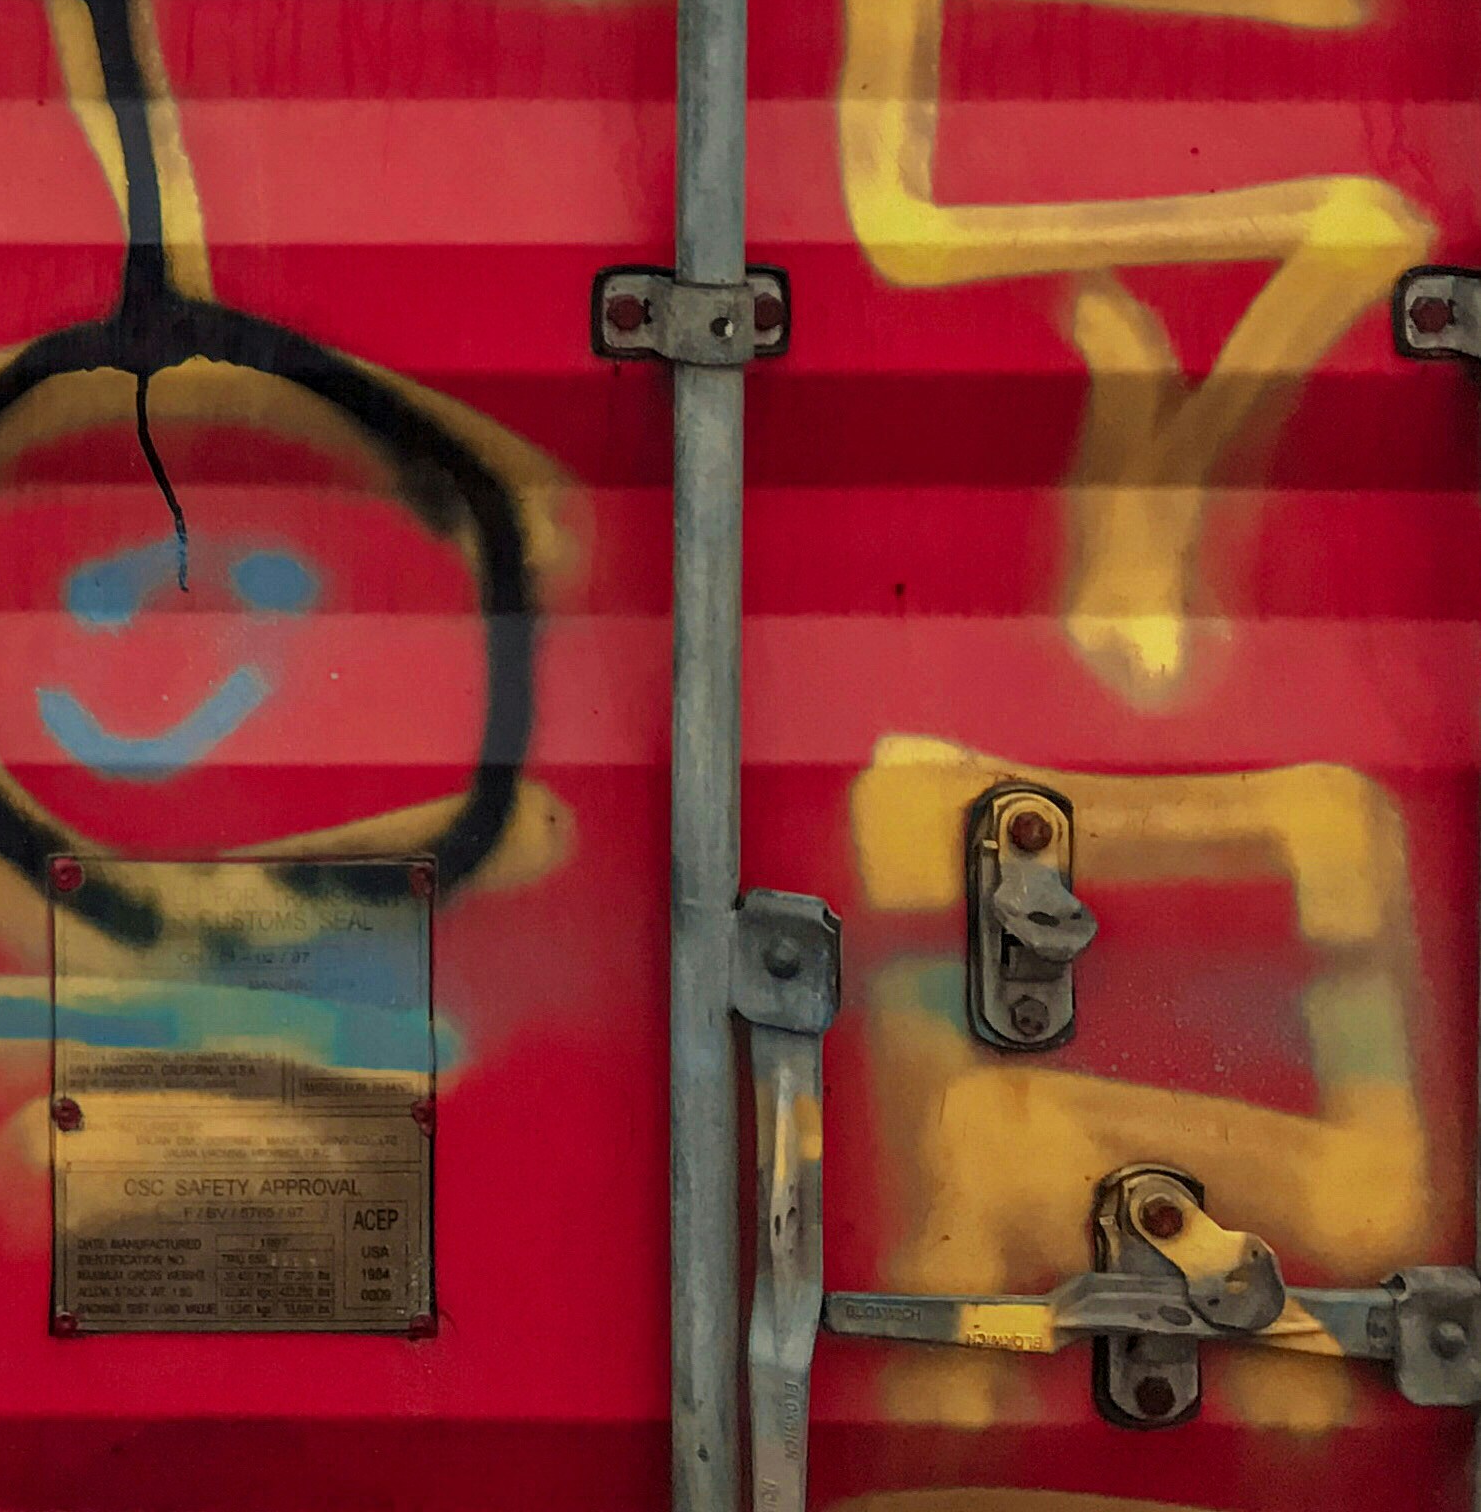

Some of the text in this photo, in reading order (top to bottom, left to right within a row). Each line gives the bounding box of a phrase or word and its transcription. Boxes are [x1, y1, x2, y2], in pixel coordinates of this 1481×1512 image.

[124, 1178, 361, 1197] CSC SAFETY APPROVAL
[353, 1209, 399, 1230] ACEP
[361, 1246, 390, 1258] USA
